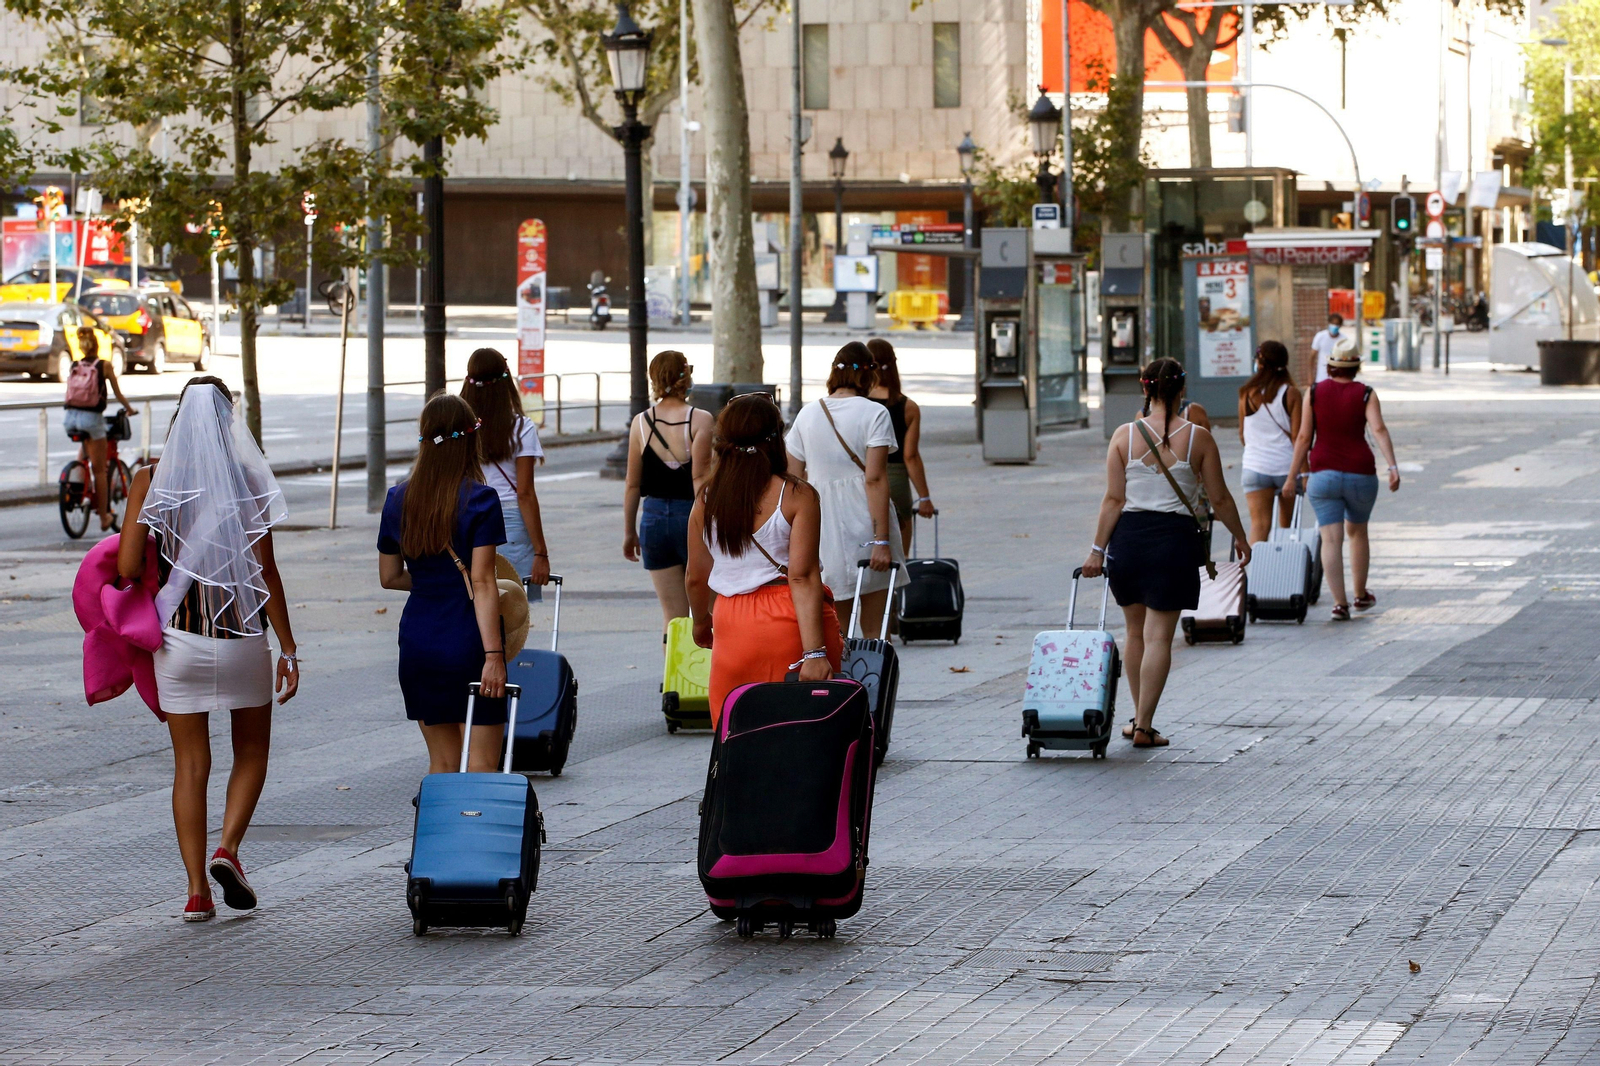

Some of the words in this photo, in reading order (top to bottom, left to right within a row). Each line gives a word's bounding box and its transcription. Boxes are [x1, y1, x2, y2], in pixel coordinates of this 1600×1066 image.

[1182, 238, 1227, 256] saba
[1213, 261, 1246, 275] KFC
[1225, 277, 1237, 299] 3
